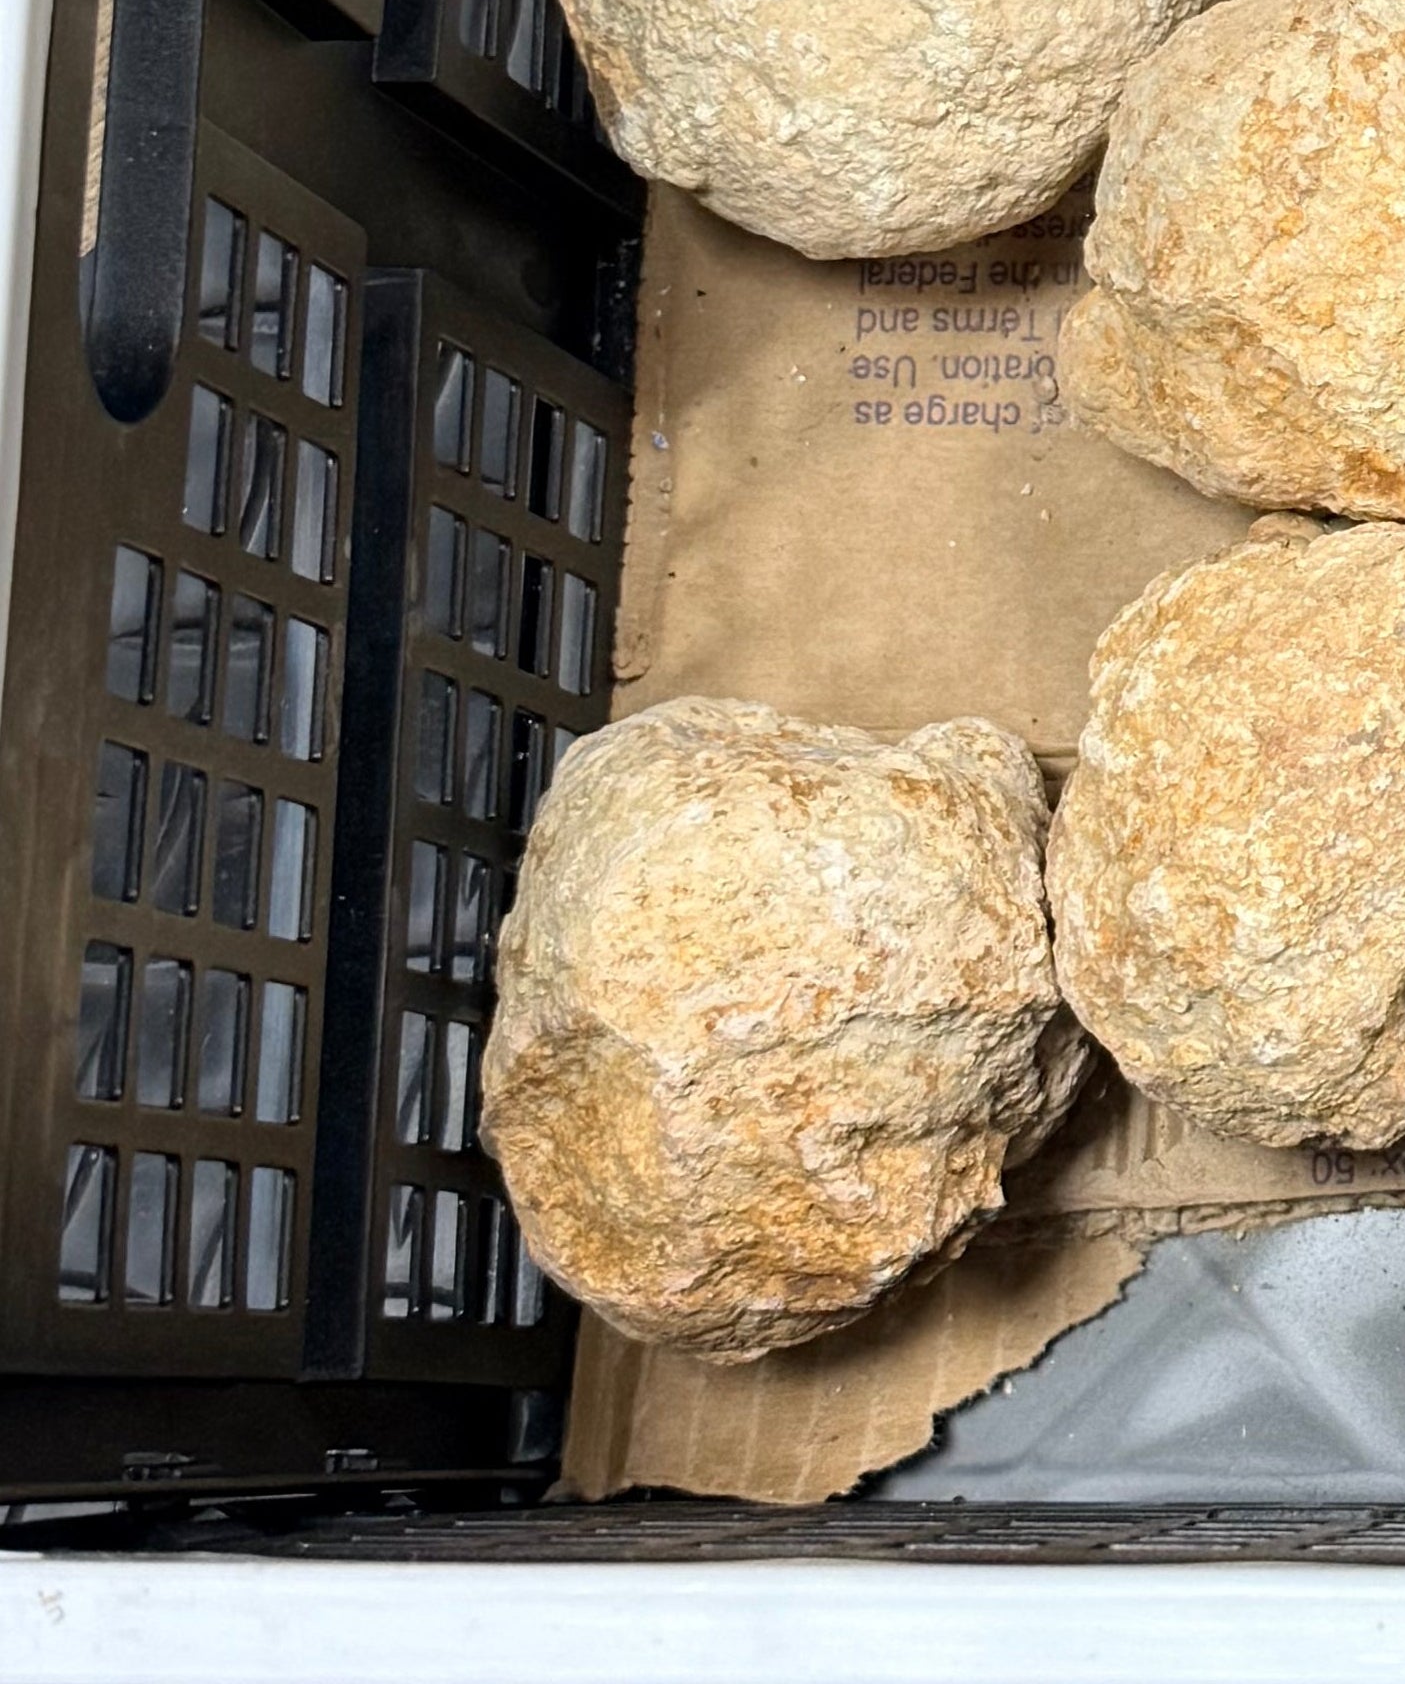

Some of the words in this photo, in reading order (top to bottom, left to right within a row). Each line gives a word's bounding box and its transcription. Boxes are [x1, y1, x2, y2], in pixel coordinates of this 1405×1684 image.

[859, 261, 978, 294] Federal
[990, 261, 1040, 293] the
[1051, 261, 1081, 294] in
[856, 307, 919, 341] and
[932, 307, 1043, 341] Terms
[852, 354, 917, 388] Use
[854, 400, 893, 424] as
[905, 395, 1021, 433] charge
[1312, 1151, 1355, 1185] 50
